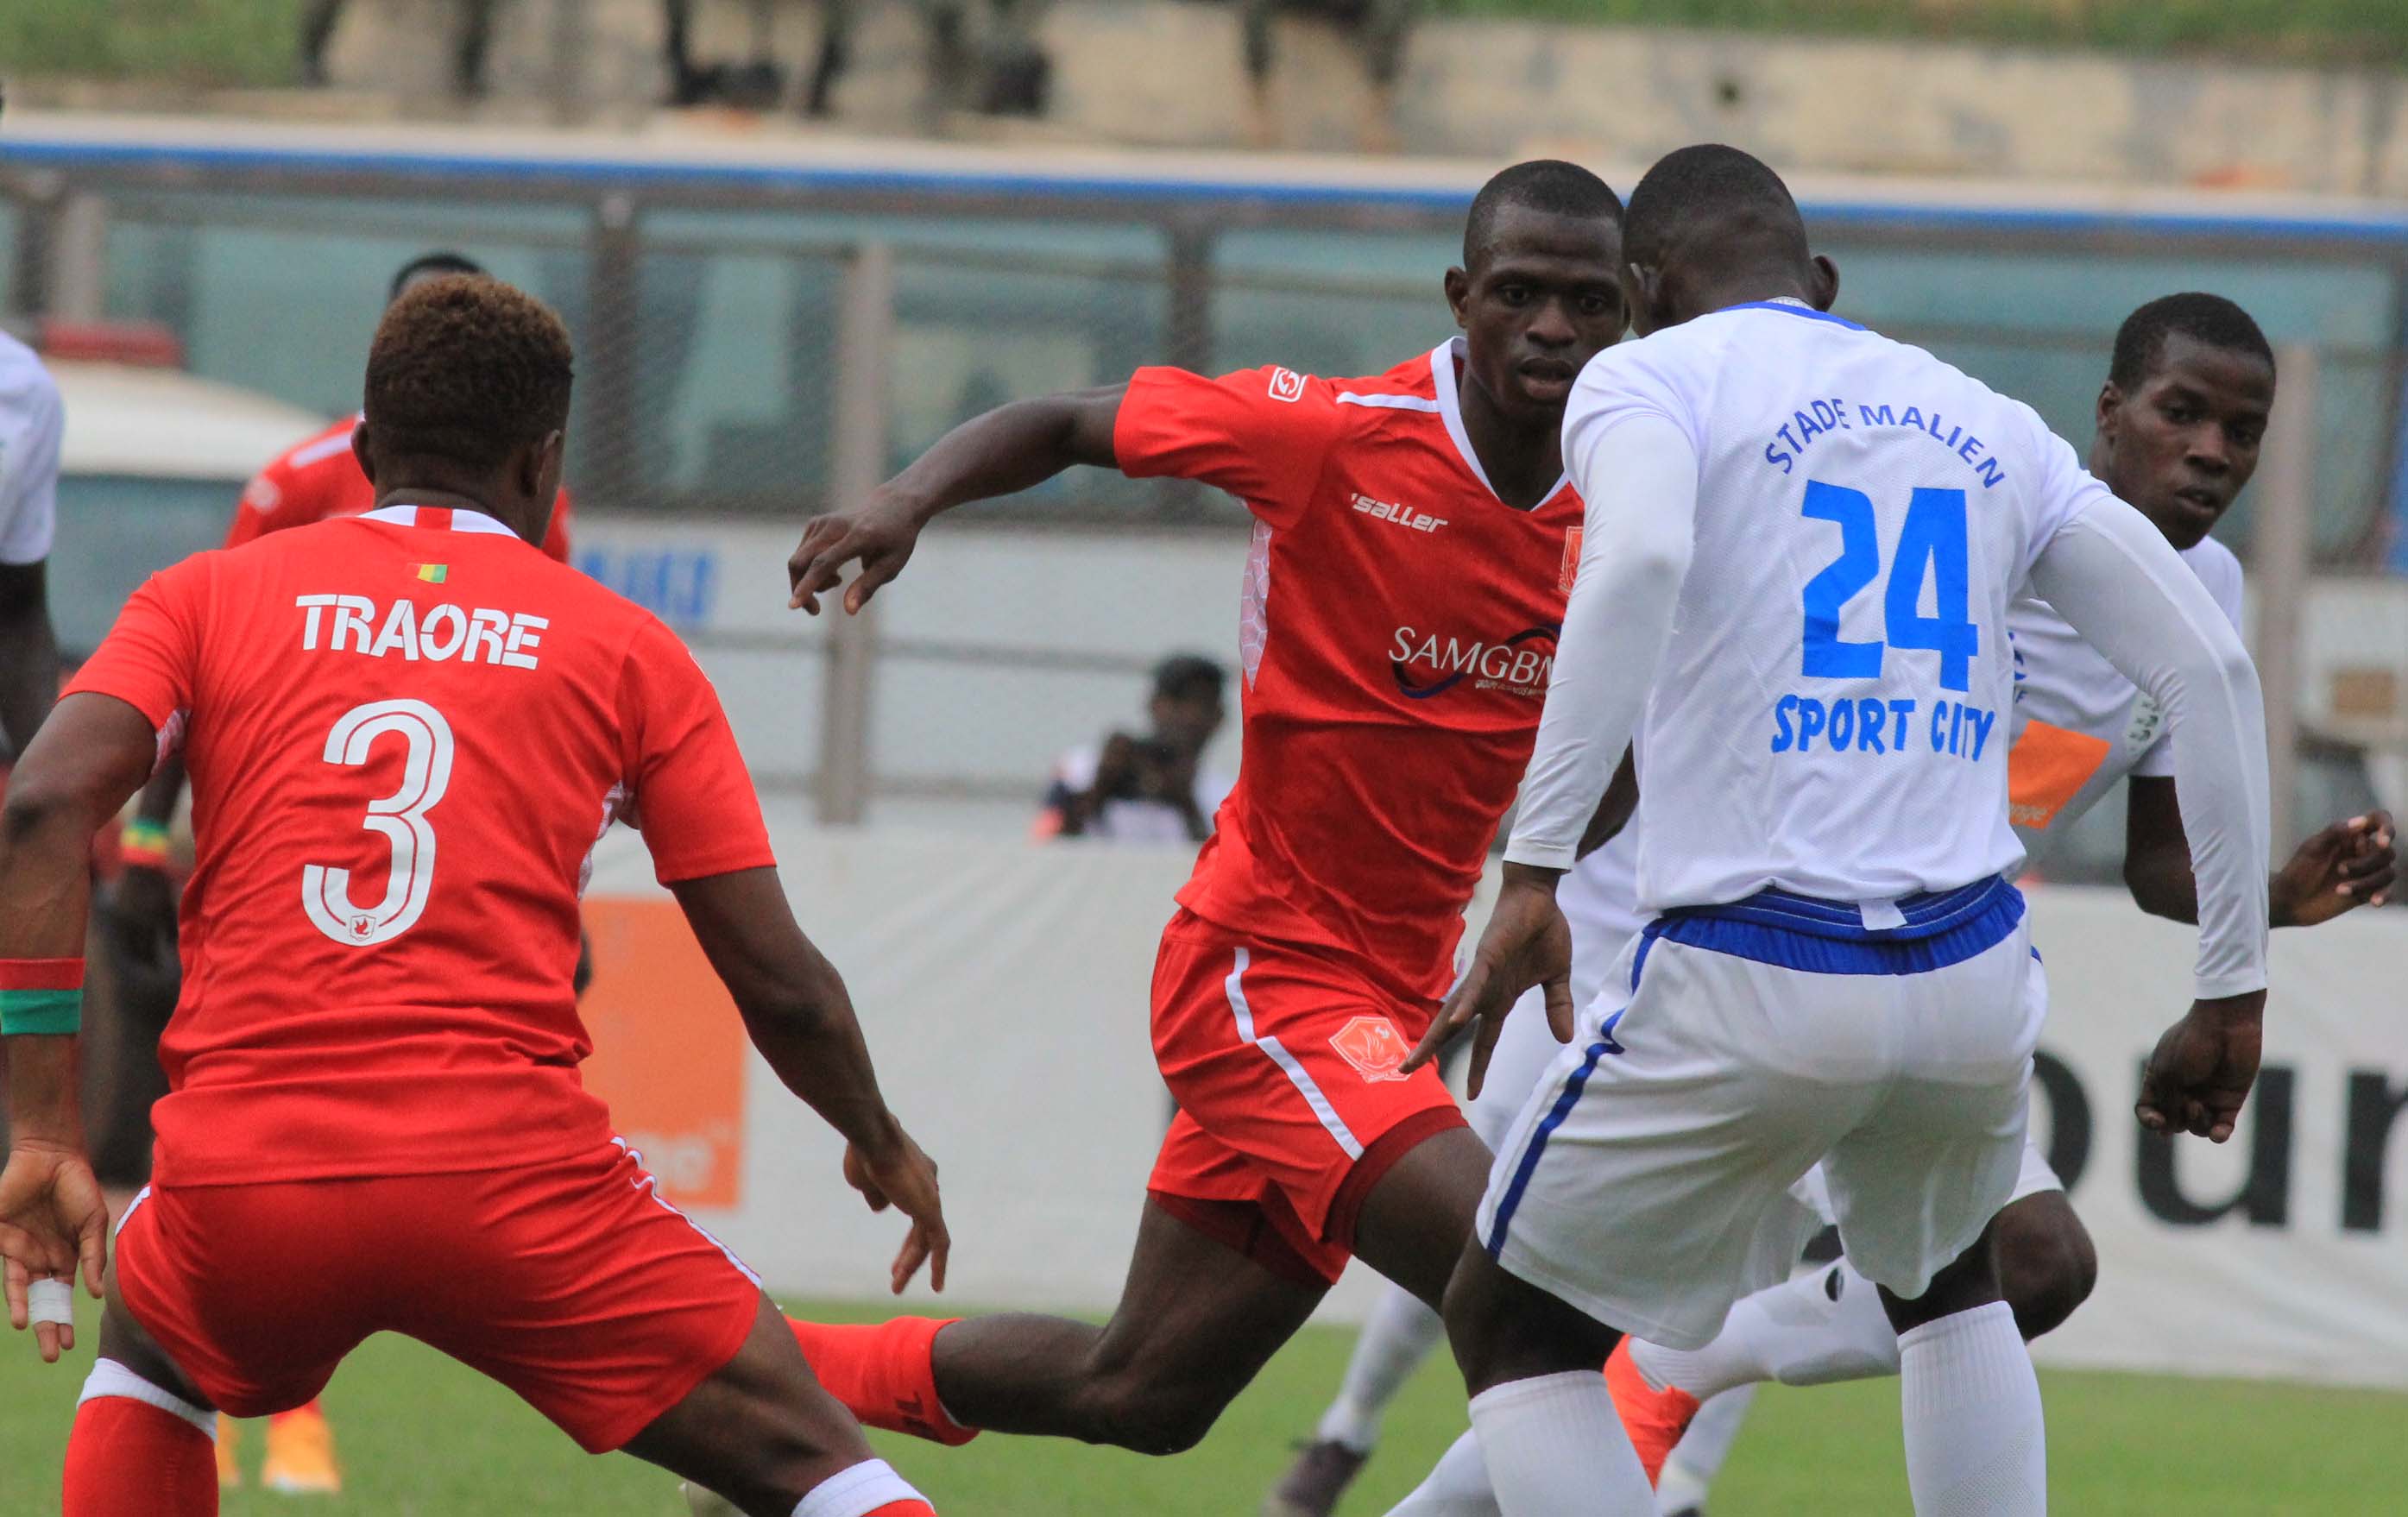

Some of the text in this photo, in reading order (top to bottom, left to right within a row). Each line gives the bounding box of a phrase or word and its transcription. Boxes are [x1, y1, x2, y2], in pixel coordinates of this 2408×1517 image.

[1765, 398, 2006, 489] STADE MALIEN
[1800, 479, 1978, 692] 24
[295, 594, 550, 670] TRAORE
[1771, 693, 1995, 763] SPORT CITY
[301, 698, 456, 947] 3
